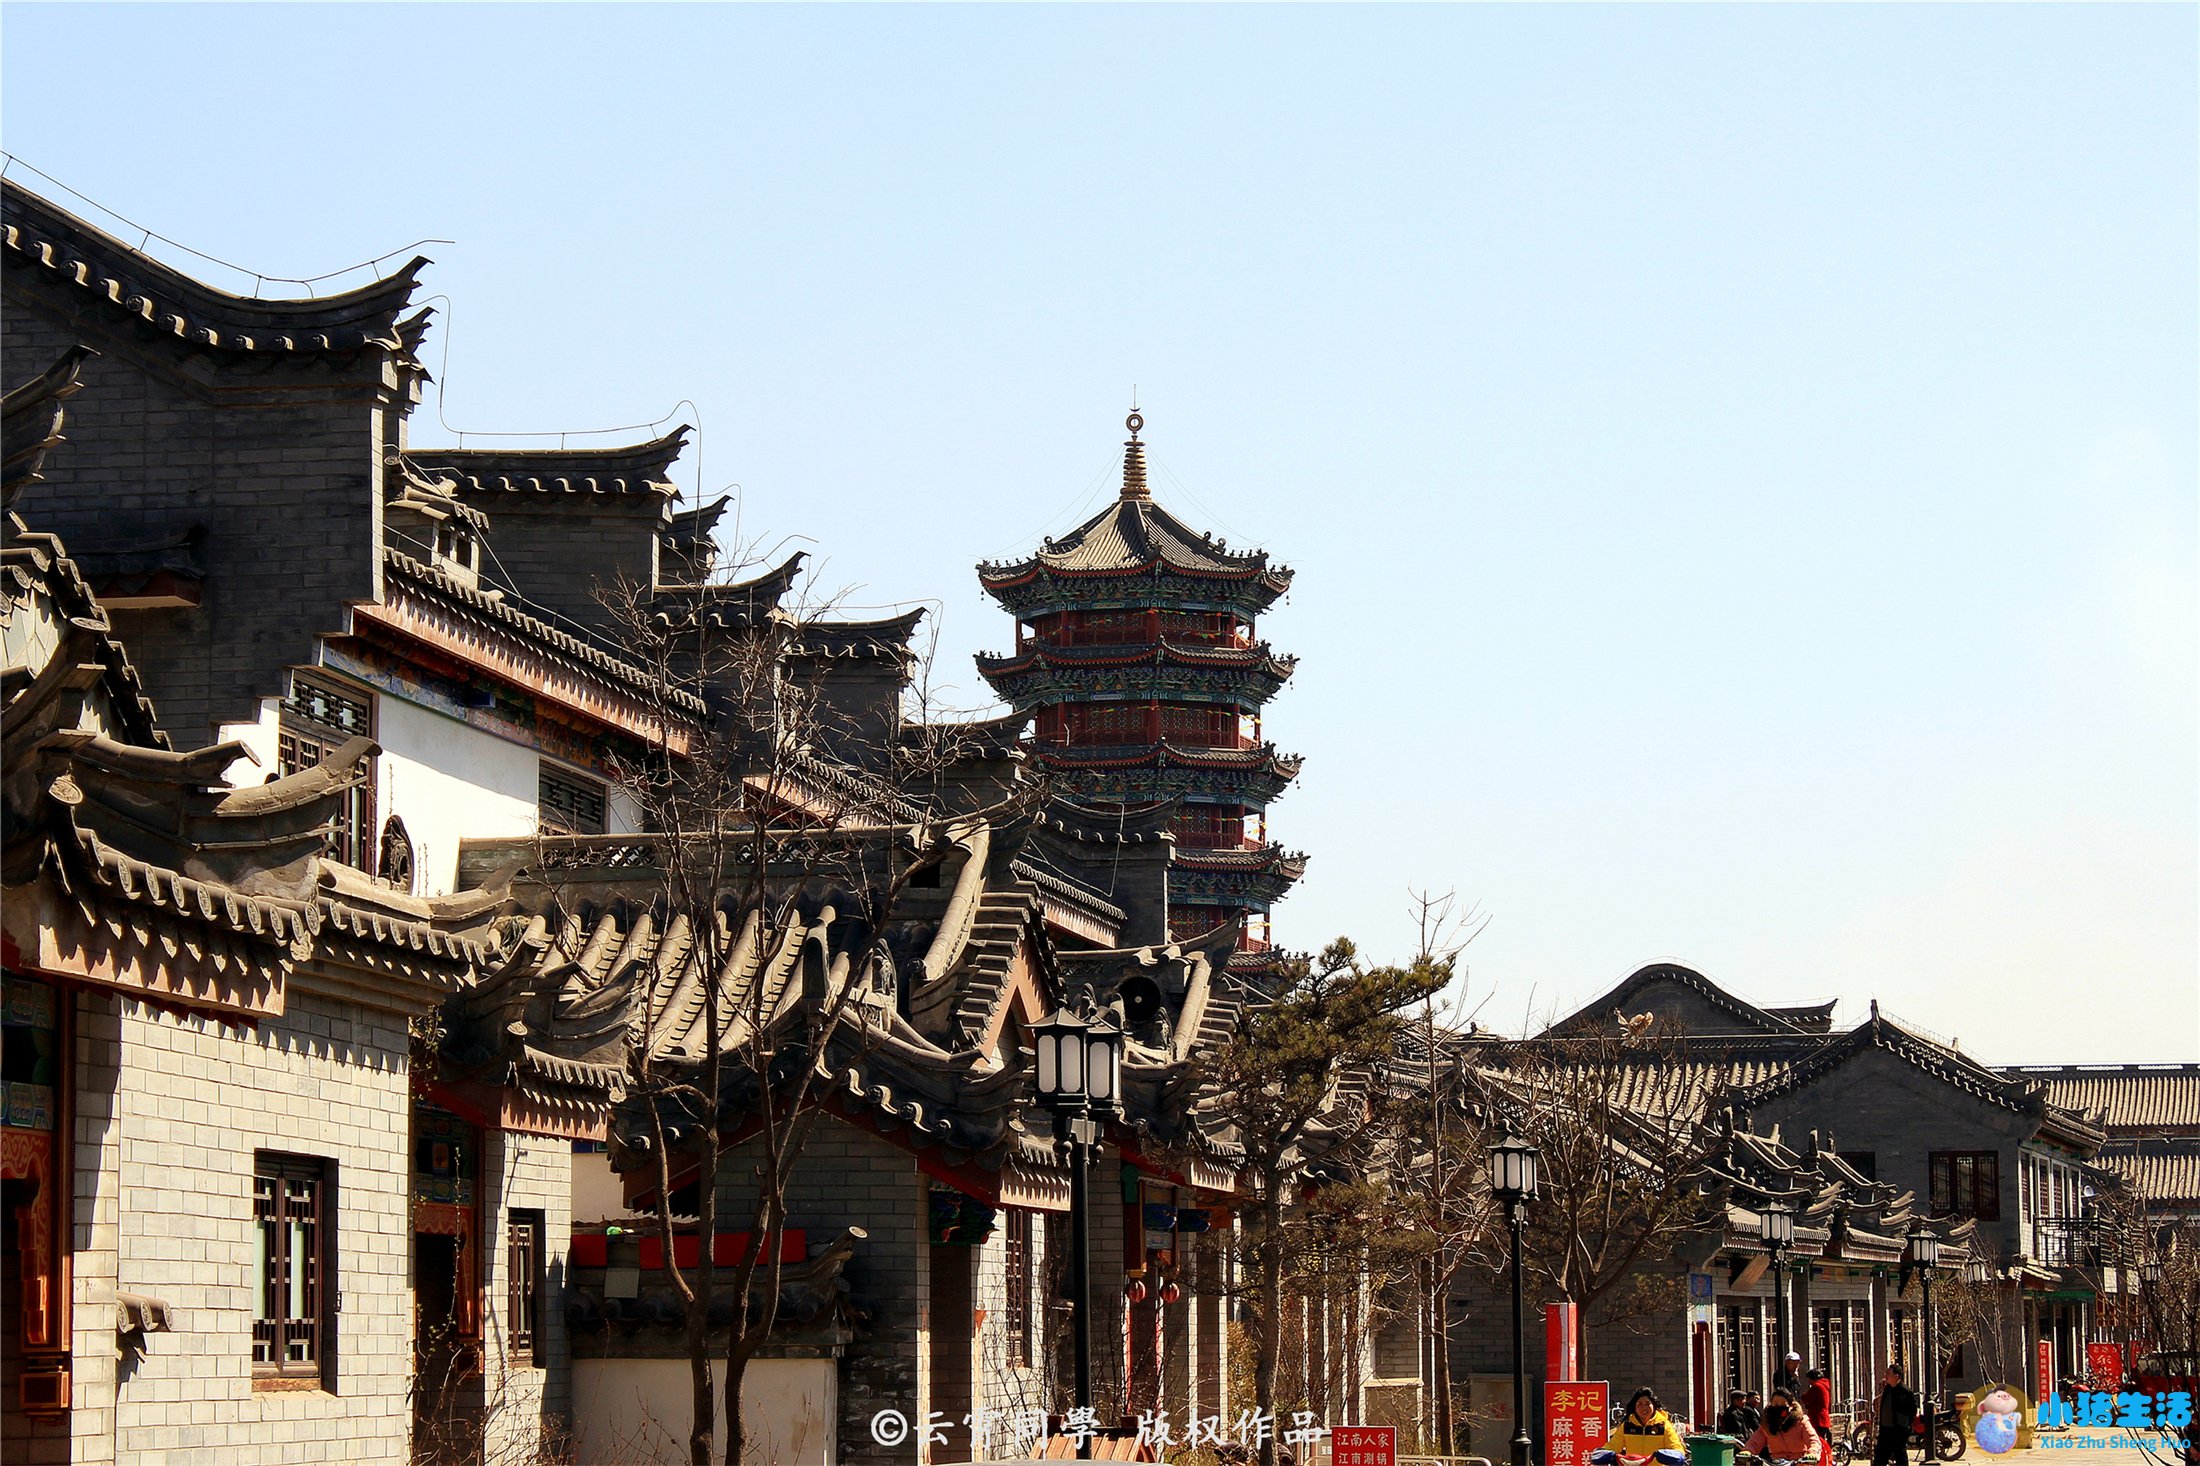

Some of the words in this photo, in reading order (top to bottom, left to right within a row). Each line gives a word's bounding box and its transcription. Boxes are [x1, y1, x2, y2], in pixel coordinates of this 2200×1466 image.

[1550, 1389, 1603, 1412] 李记
[1337, 1432, 1389, 1448] 江南人家
[1338, 1452, 1388, 1465] 江南涮锅
